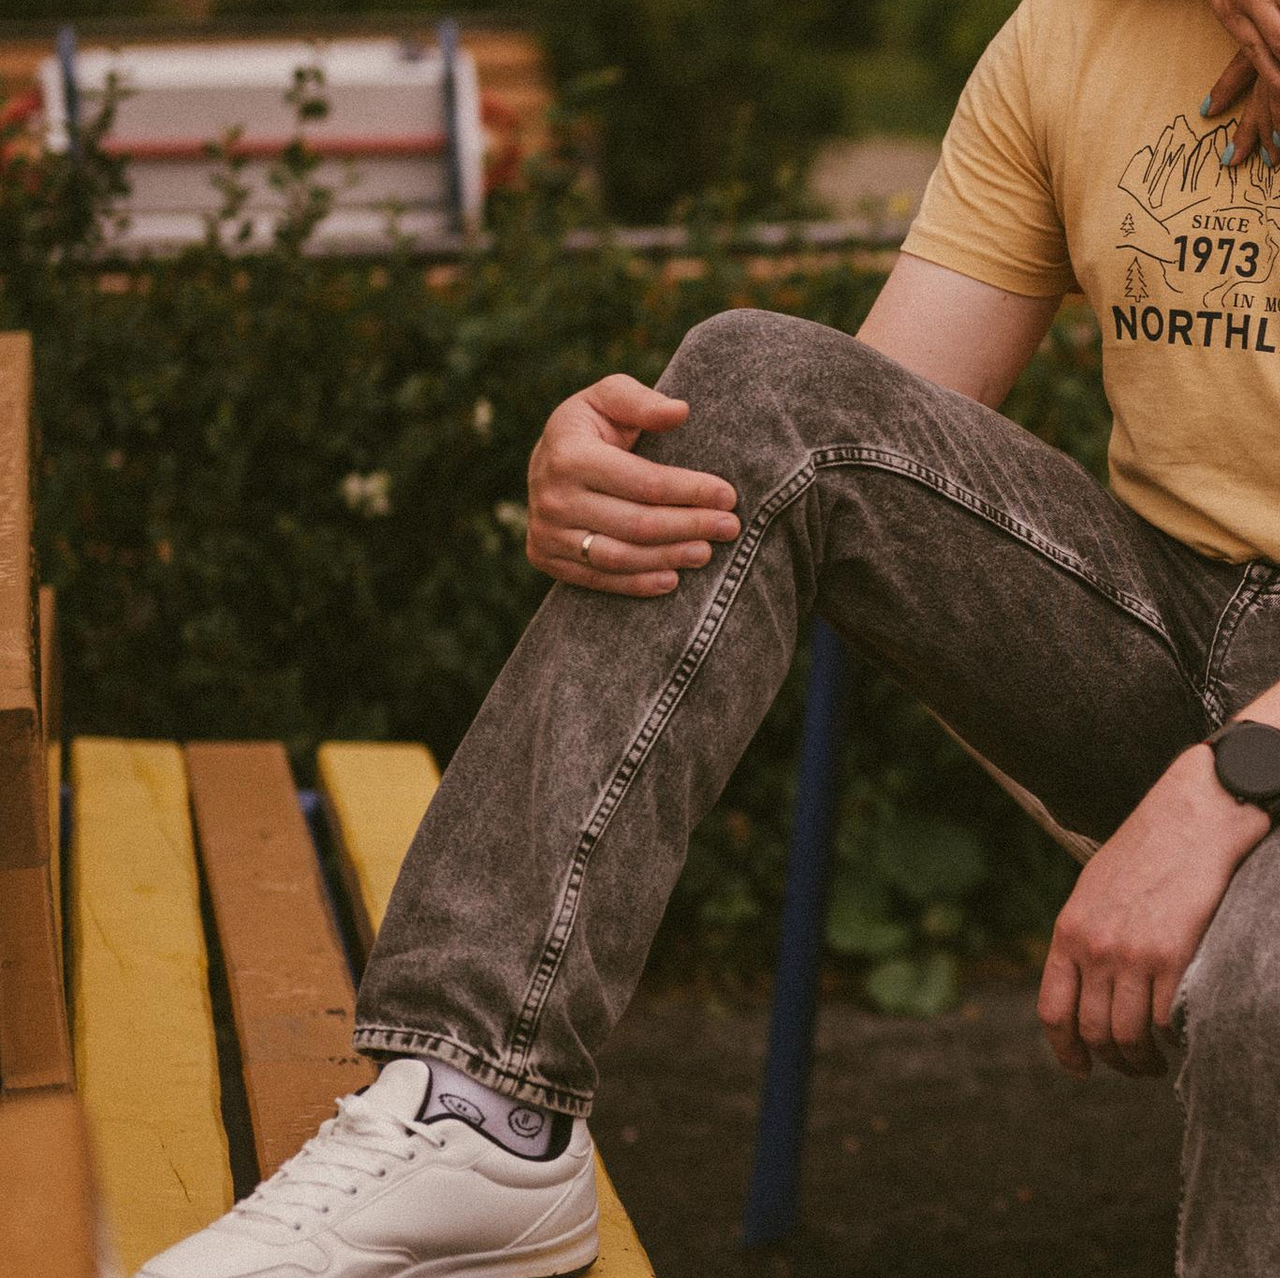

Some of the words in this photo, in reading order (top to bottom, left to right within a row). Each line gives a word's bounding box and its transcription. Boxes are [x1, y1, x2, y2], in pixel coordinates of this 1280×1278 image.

[1192, 214, 1250, 233] SINCE
[1173, 235, 1260, 278] 1973
[1232, 293, 1255, 309] IN
